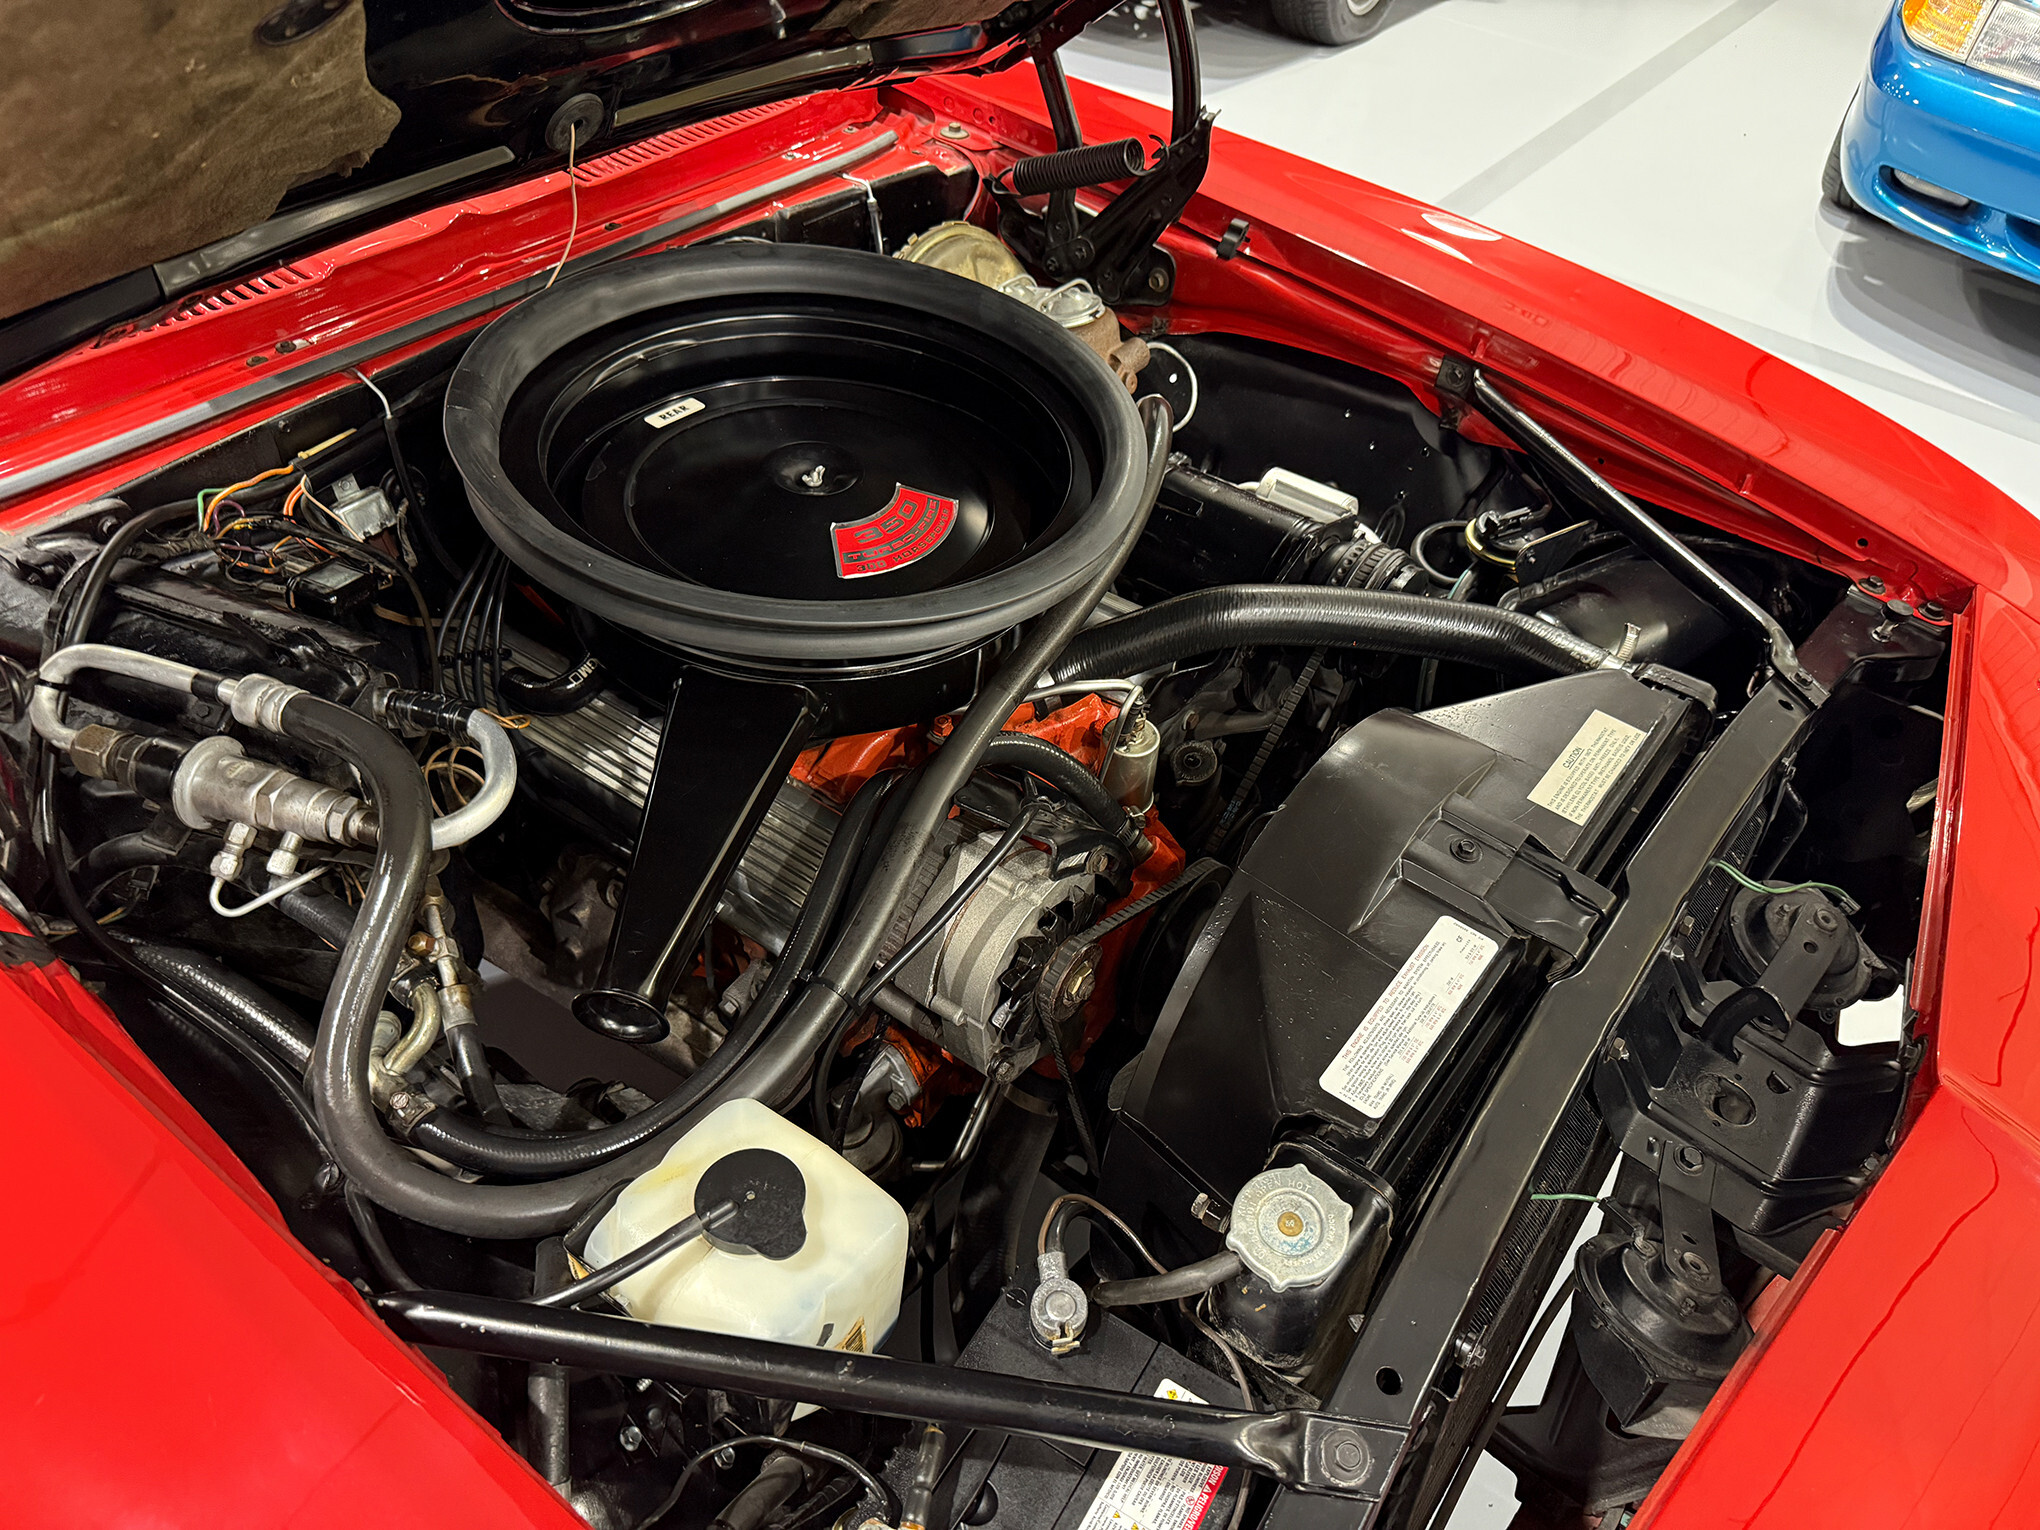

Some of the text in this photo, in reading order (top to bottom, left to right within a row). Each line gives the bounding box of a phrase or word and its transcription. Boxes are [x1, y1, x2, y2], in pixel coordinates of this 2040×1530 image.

[658, 405, 689, 420] REAR
[848, 498, 939, 560] TURBO-FIRE
[854, 500, 918, 543] 350
[856, 508, 950, 572] 300 HORSEPOWER
[1563, 747, 1582, 768] CAUTION
[1256, 1179, 1283, 1198] OPEN
[1288, 1180, 1312, 1192] HOT
